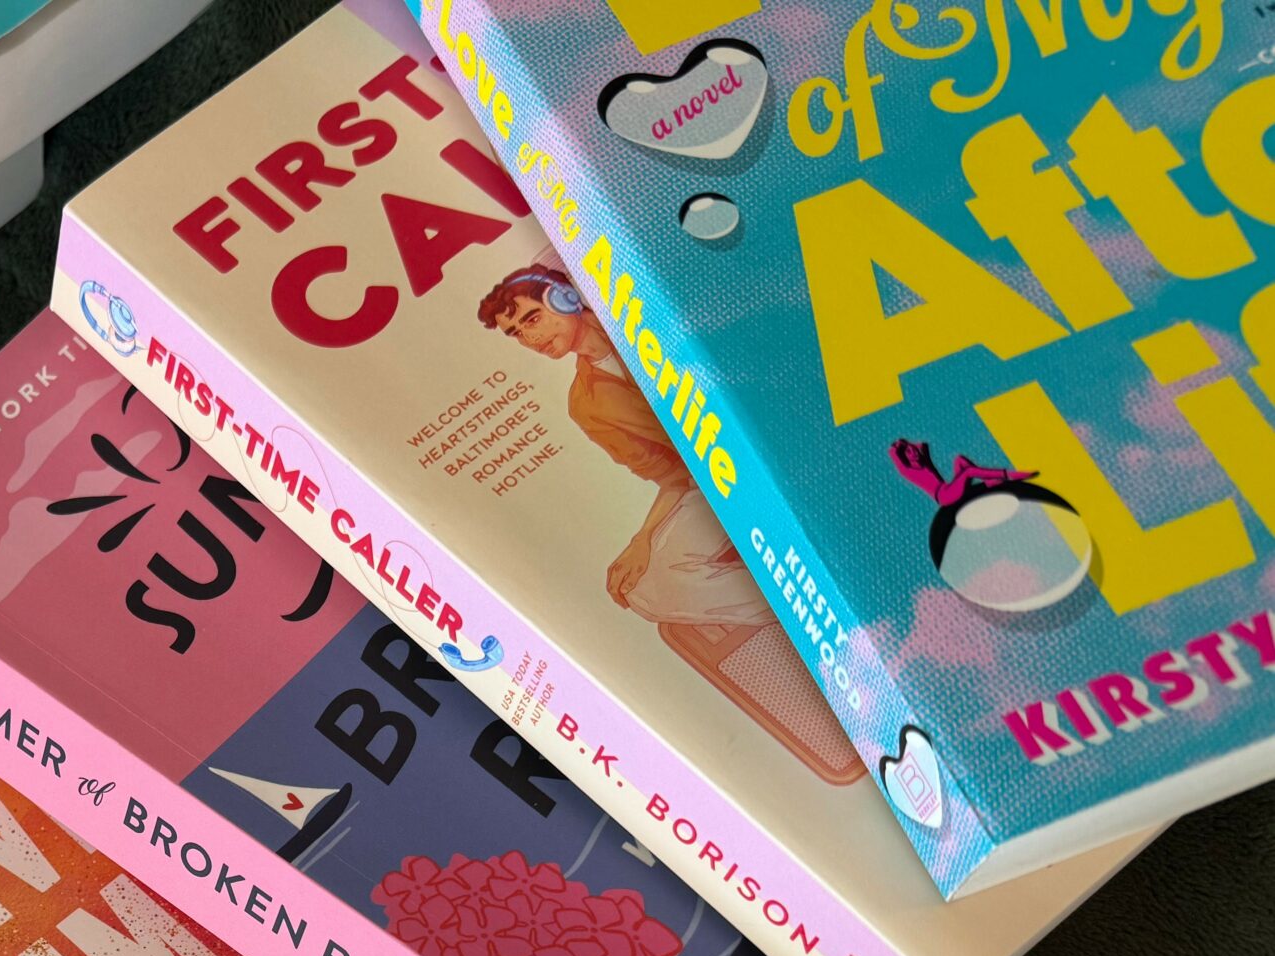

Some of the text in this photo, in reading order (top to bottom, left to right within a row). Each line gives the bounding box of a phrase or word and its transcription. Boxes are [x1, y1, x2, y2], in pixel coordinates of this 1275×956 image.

[651, 64, 743, 140] a novel
[787, 5, 885, 162] of
[172, 54, 447, 274] FIRST
[438, 0, 738, 499] Love of My Afterlife
[407, 370, 507, 448] WELCOME TO
[418, 381, 535, 469] HEARTSTRINGS,
[471, 423, 548, 484] ROMANCE
[146, 336, 464, 643] FIRST-TIME CALLER
[491, 443, 564, 497] HOTLINE.
[749, 527, 863, 712] GREENWOOD
[784, 545, 849, 648] KIRSTY
[501, 651, 533, 711] USA TODAY
[511, 659, 548, 727] BESTSELLING
[530, 683, 556, 727] AUTHOR
[1003, 610, 1275, 768] KIRSTY
[77, 775, 116, 807] of
[122, 797, 308, 950] BROKEN
[645, 793, 820, 955] BORISON
